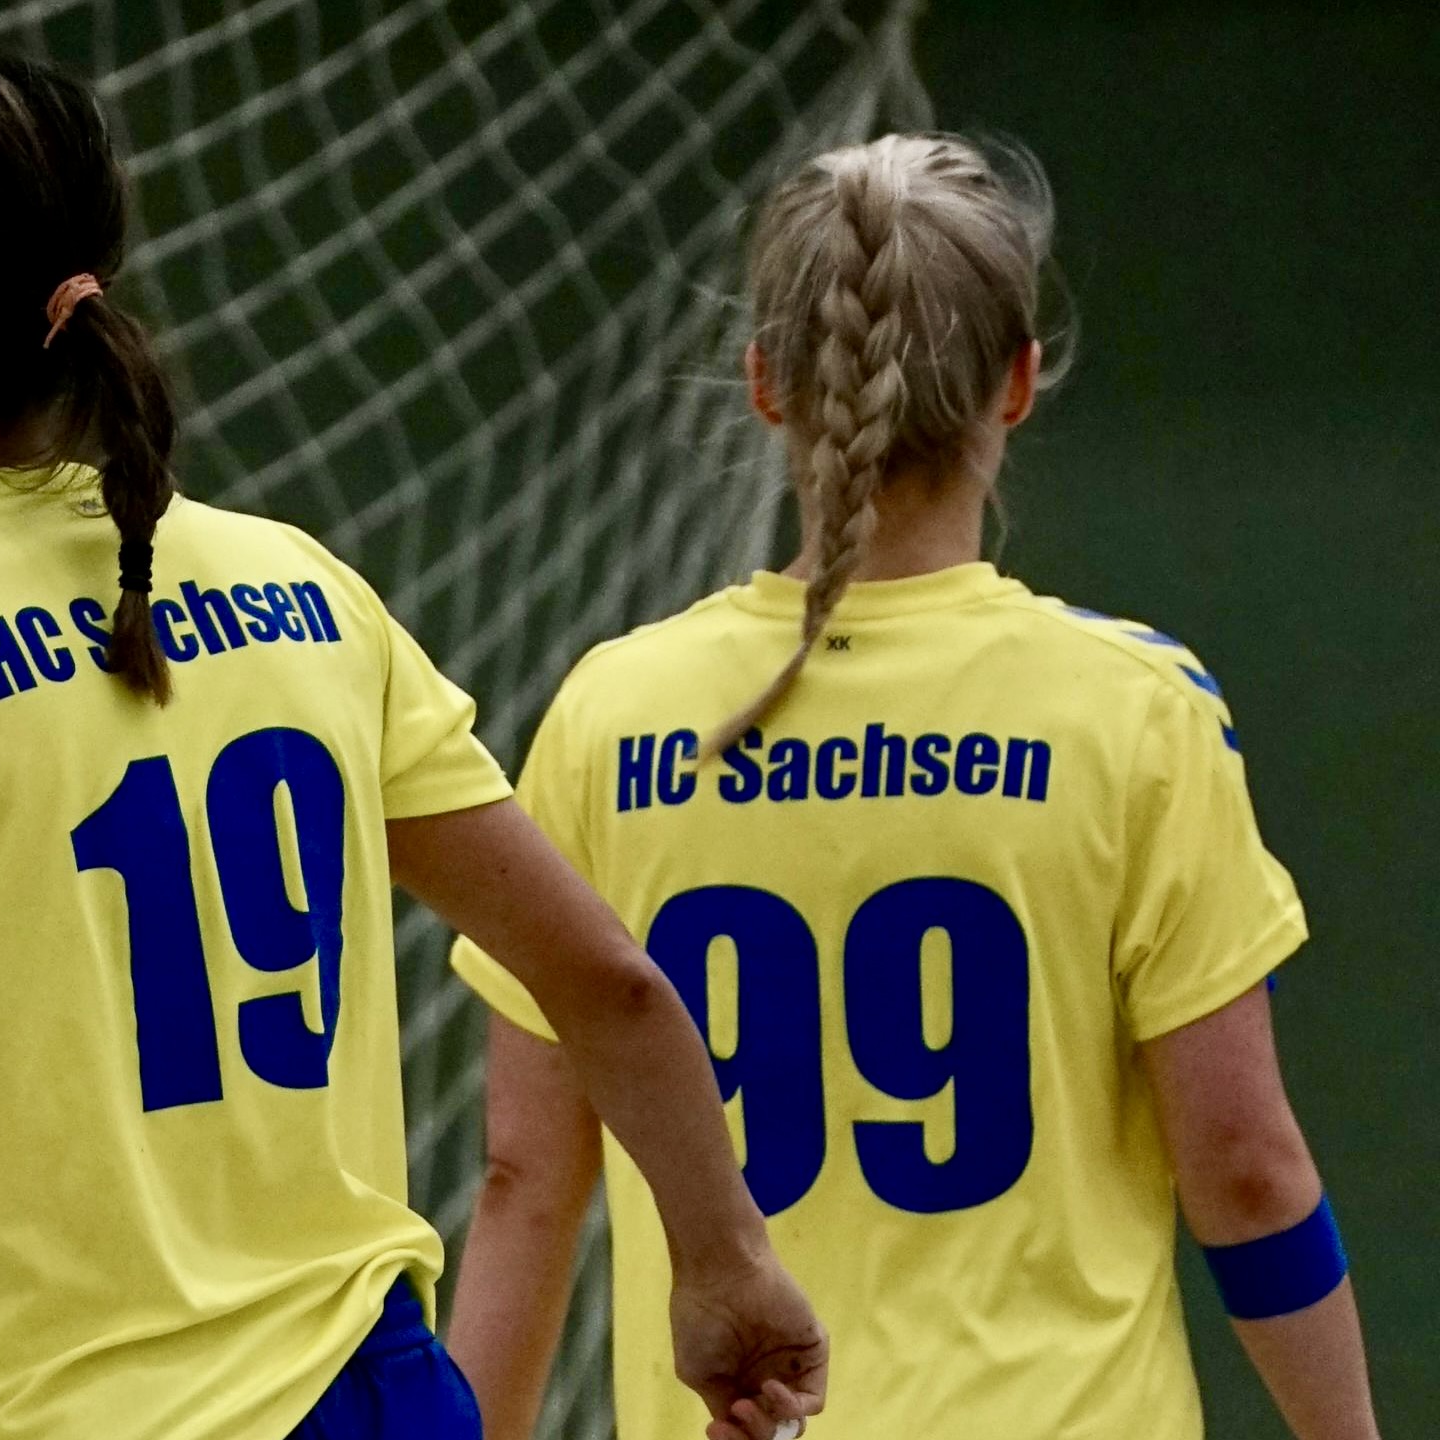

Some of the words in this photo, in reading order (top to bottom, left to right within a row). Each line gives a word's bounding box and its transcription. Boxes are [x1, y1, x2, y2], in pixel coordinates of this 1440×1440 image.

[69, 580, 343, 673] Schsen
[616, 728, 698, 813] HC
[718, 722, 1052, 804] Sachsen
[70, 726, 345, 1113] 19
[645, 876, 1034, 1218] 99
